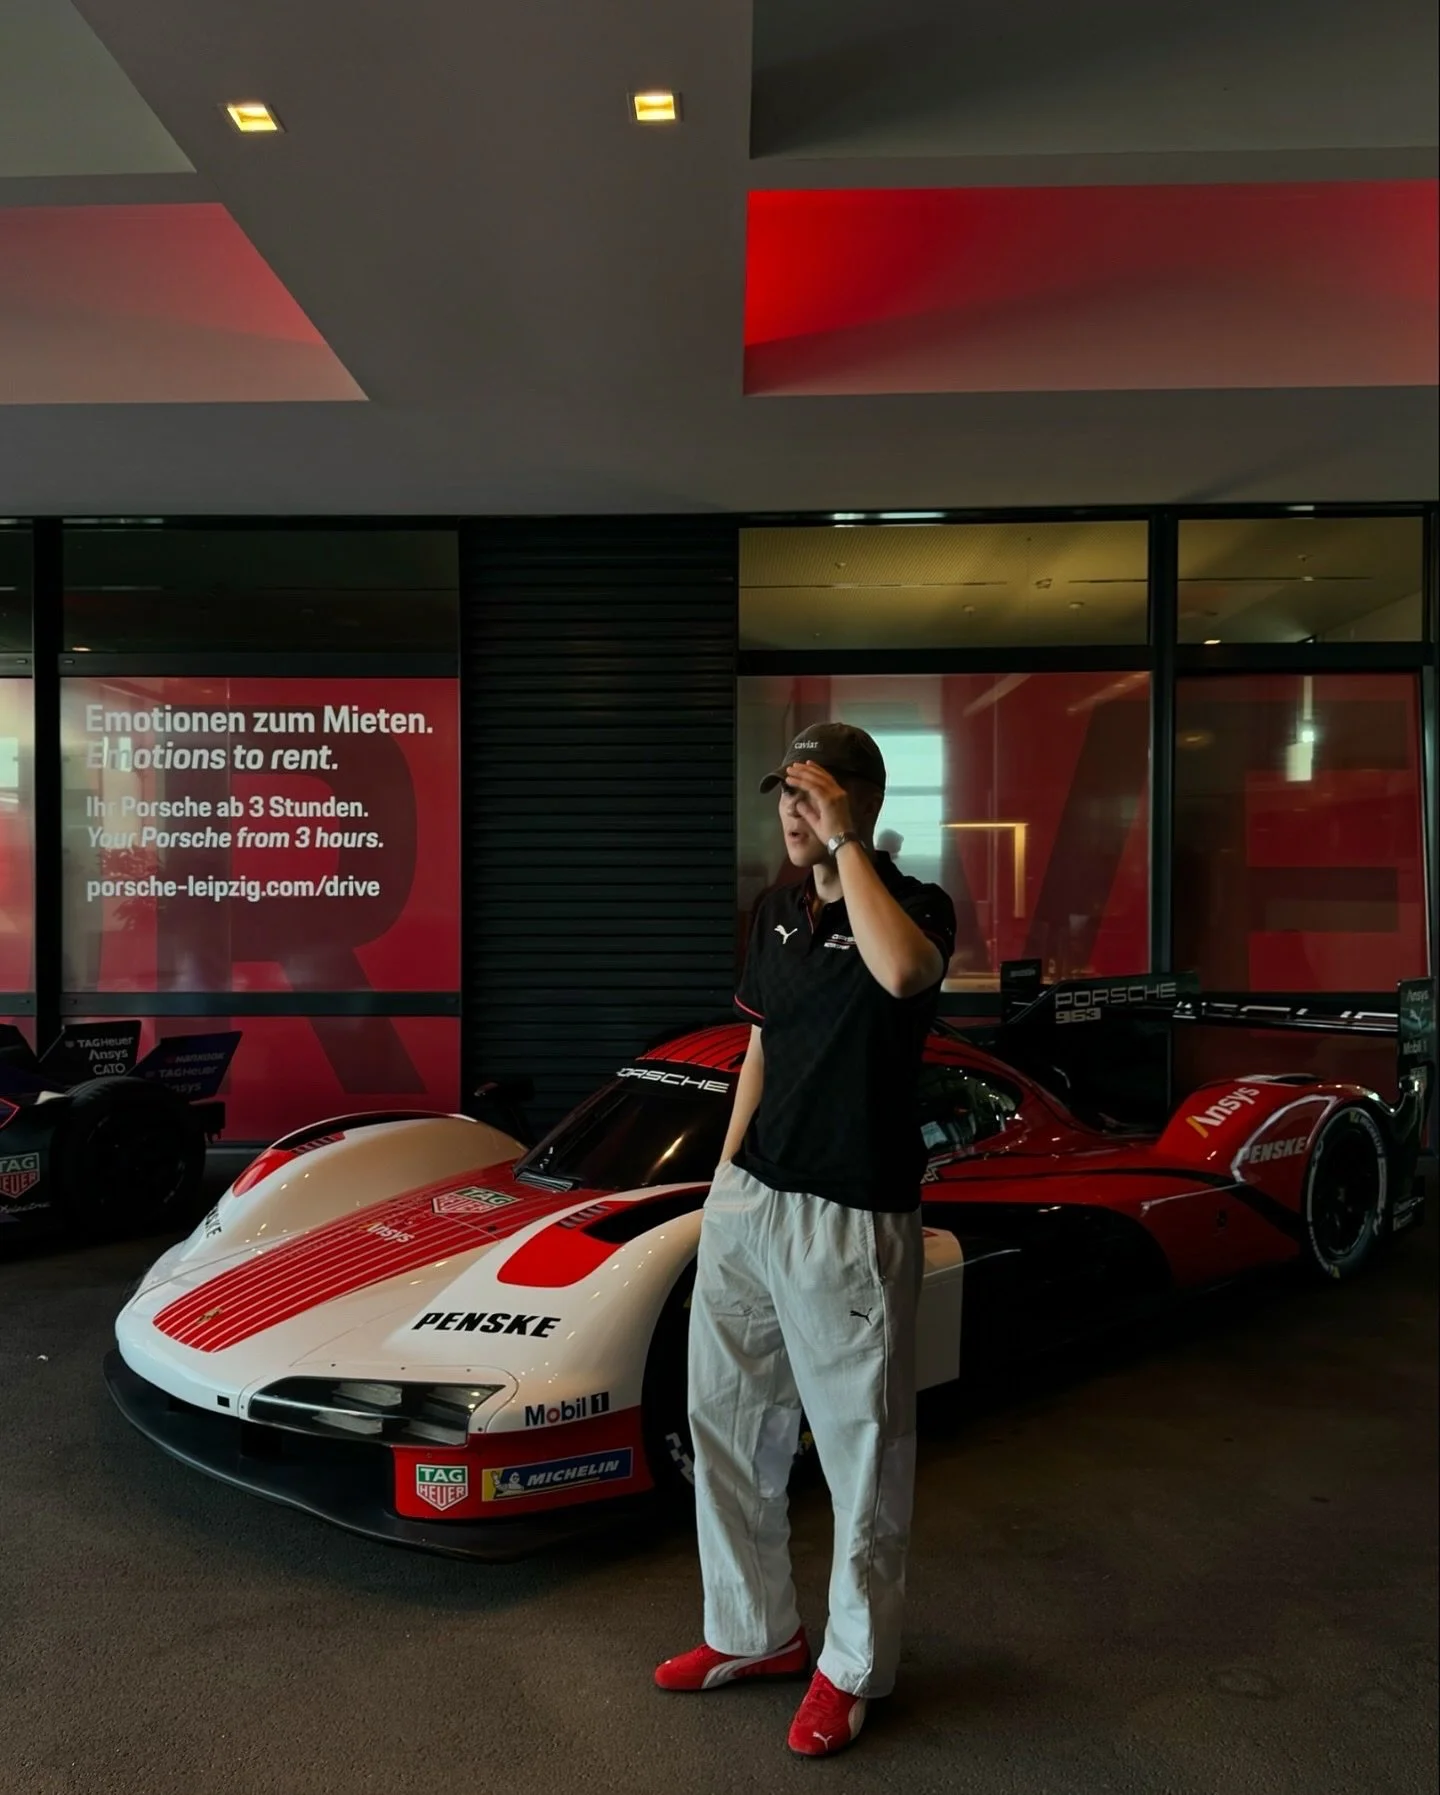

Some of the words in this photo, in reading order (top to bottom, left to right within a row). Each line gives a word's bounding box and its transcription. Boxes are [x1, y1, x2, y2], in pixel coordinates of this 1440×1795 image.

[86, 705, 245, 733] Emotionen
[252, 712, 315, 733] zum
[323, 705, 433, 734] Mieten.
[233, 745, 264, 770] to
[270, 745, 339, 770] rent.
[86, 796, 116, 817] Ihr
[121, 796, 212, 818] Porsche
[216, 796, 244, 817] ab
[248, 796, 264, 817] 3
[269, 796, 369, 818] Stunden.
[87, 827, 137, 849] Your
[141, 827, 232, 849] Porsche
[236, 827, 290, 848] from
[295, 827, 311, 848] 3
[315, 827, 384, 848] hours.
[86, 875, 380, 902] porsche-leipzig.com/drive
[1055, 982, 1177, 1009] PORSCHE
[1055, 1007, 1102, 1025] 963
[92, 1062, 126, 1076] CATO
[1185, 1087, 1260, 1139] Ansys
[463, 1188, 514, 1206] TAG
[358, 1221, 415, 1243] Ansys
[412, 1312, 562, 1338] PENSKE
[525, 1397, 586, 1427] Mobil
[591, 1392, 609, 1414] 1
[419, 1468, 465, 1483] TAG
[527, 1459, 620, 1488] MICHELIN
[418, 1485, 466, 1510] HEUER
